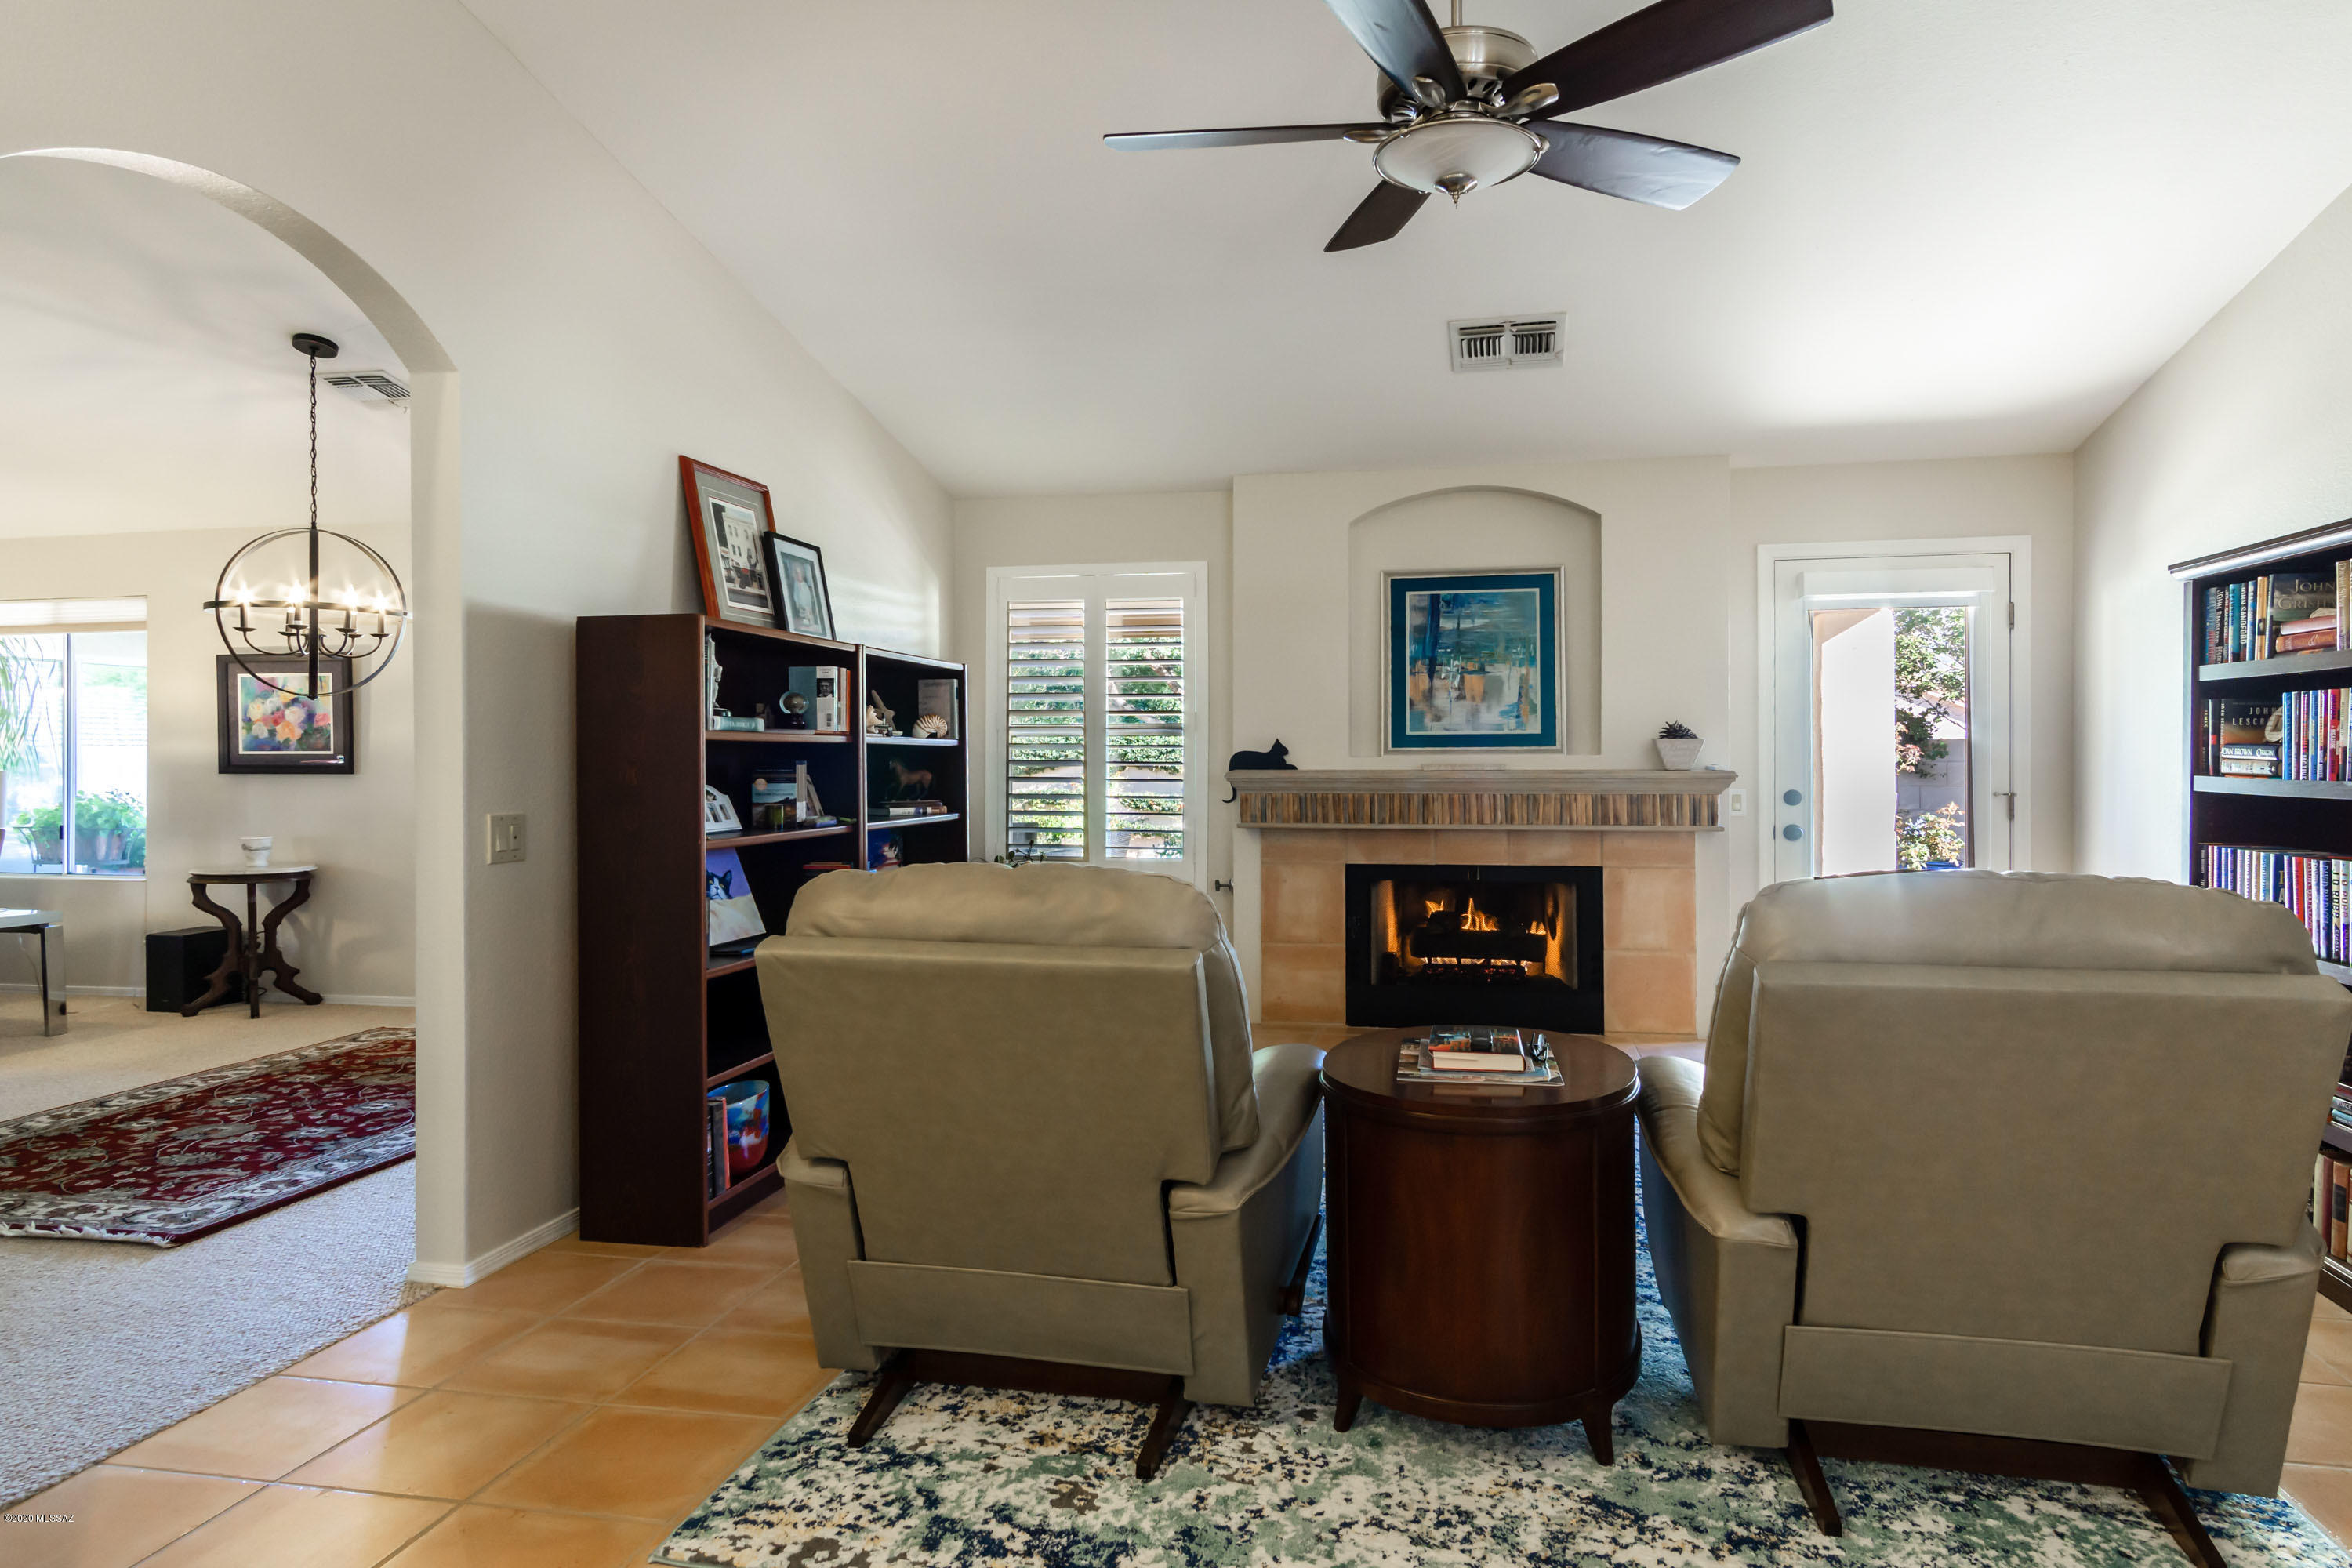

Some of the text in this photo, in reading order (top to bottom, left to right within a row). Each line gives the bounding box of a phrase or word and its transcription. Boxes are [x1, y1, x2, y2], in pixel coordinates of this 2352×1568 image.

[2295, 579, 2336, 593] JOHN
[2278, 597, 2336, 610] GRISH
[2232, 717, 2265, 726] LESCR
[2222, 747, 2234, 756] DAN
[2234, 747, 2252, 756] BROWN
